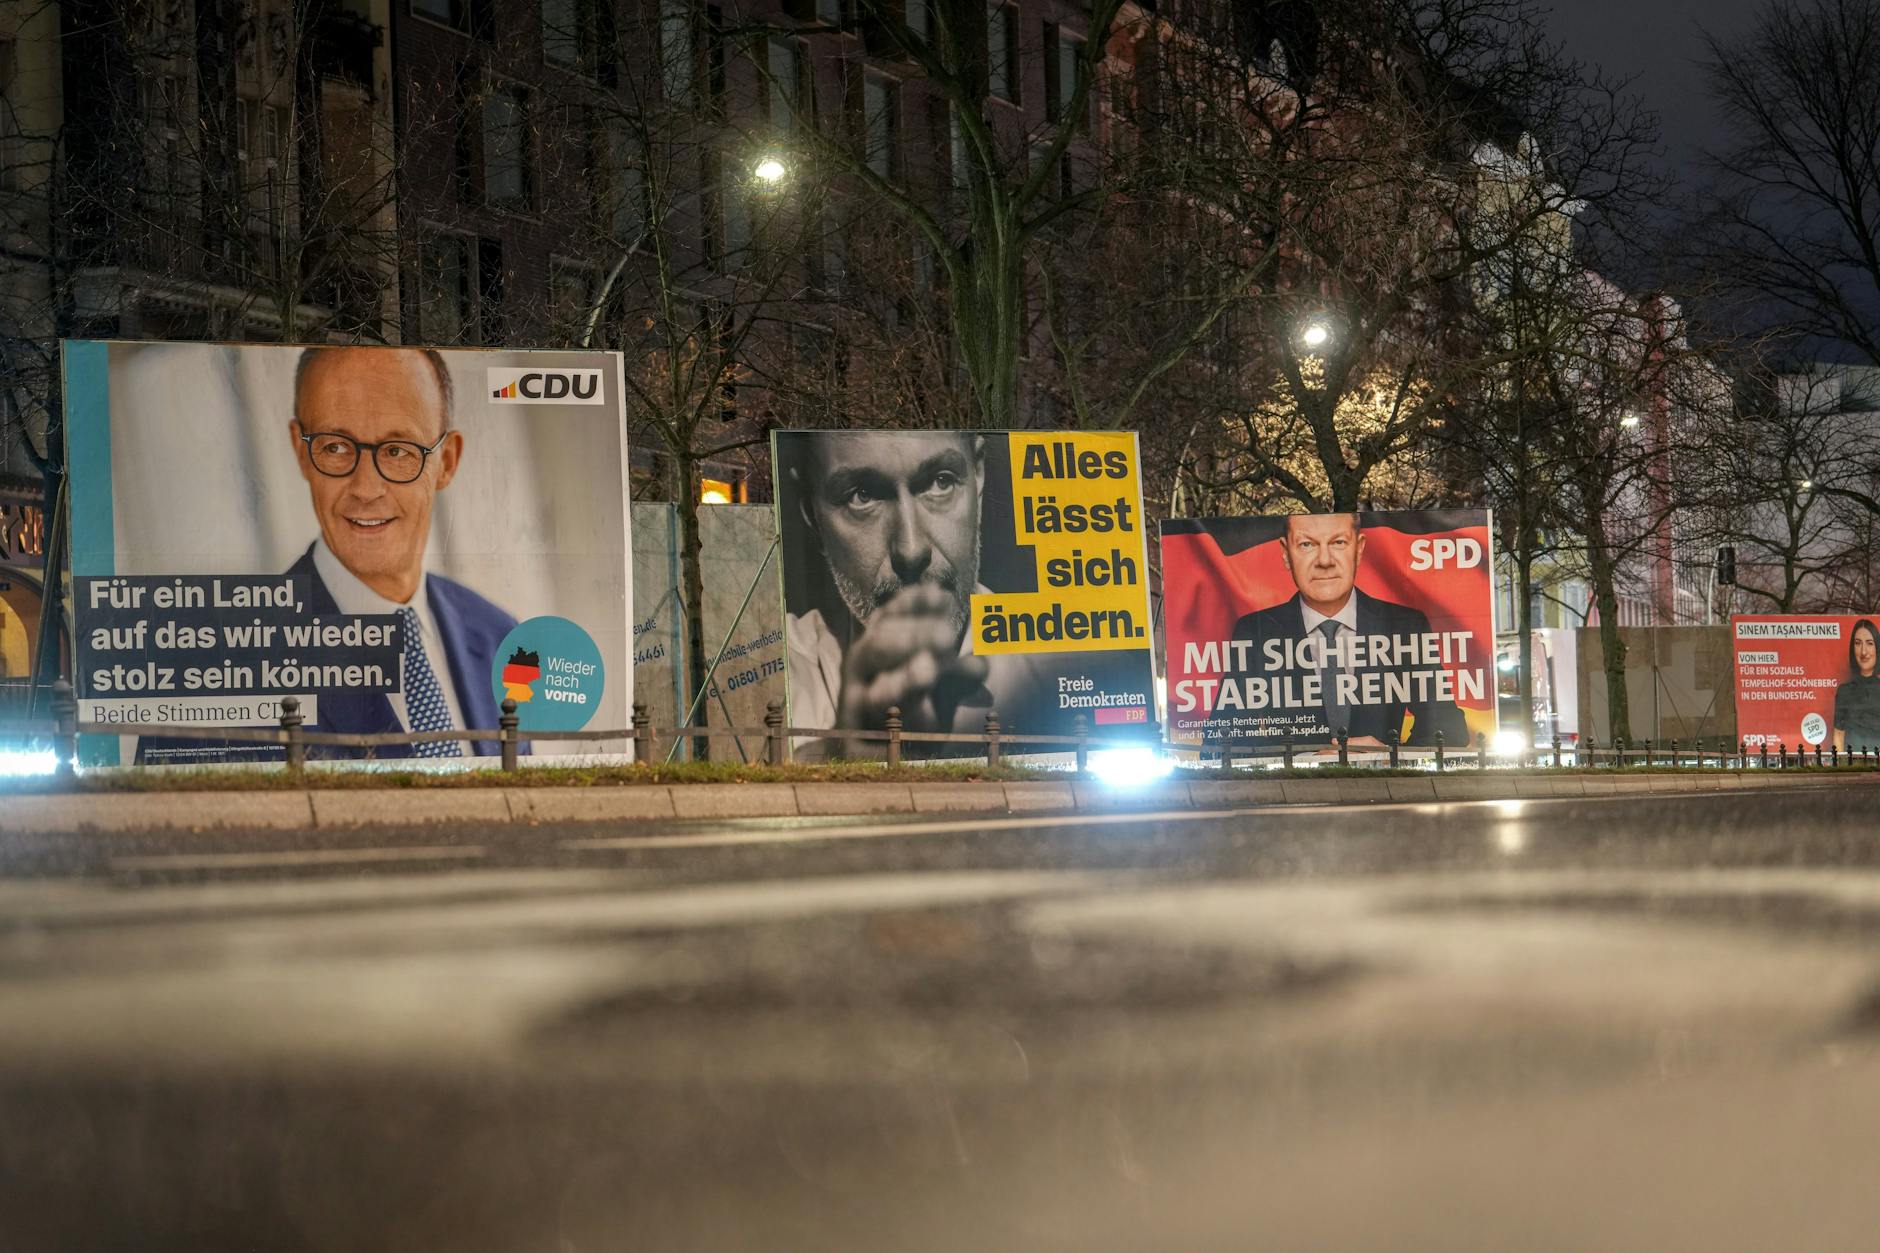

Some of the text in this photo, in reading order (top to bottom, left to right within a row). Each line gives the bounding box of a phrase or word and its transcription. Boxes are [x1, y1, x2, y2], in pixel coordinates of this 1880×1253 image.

[518, 373, 598, 399] CDU
[1022, 442, 1129, 479] Alles
[1023, 495, 1133, 534] lässt
[1410, 538, 1482, 571] SPD
[1047, 548, 1136, 587] sich
[89, 578, 304, 615] Für ein Land,
[981, 603, 1145, 643] ändern.
[1738, 625, 1838, 638] SINEM TAŞAN-FUNKE
[91, 616, 396, 651] auf das wir wieder
[1184, 631, 1473, 674] MIT SICHERHEIT
[1739, 654, 1777, 663] VON HIER.
[92, 657, 392, 691] stolz sein können.
[547, 656, 596, 676] Wieder
[1740, 665, 1804, 675] FÜR EIN SOZIALES
[545, 674, 579, 689] nach
[1058, 676, 1094, 692] Freie
[1175, 668, 1485, 713] STABILE RENTEN
[1741, 677, 1838, 688] TEMPELHOF-SCHÖNEBERG
[544, 689, 587, 704] vorne
[1058, 691, 1147, 708] Demokraten
[1741, 690, 1816, 700] IN DEN BUNDESTAG.
[93, 704, 151, 723] Beide
[157, 702, 251, 722] Stimmen
[1126, 709, 1145, 720] FDP
[1177, 714, 1316, 729] Garantiertes Rentenniveau. Jetzt
[1178, 729, 1196, 740] und
[1197, 729, 1205, 739] in
[1207, 728, 1243, 738] Zuknft:
[1743, 734, 1765, 746] SPD
